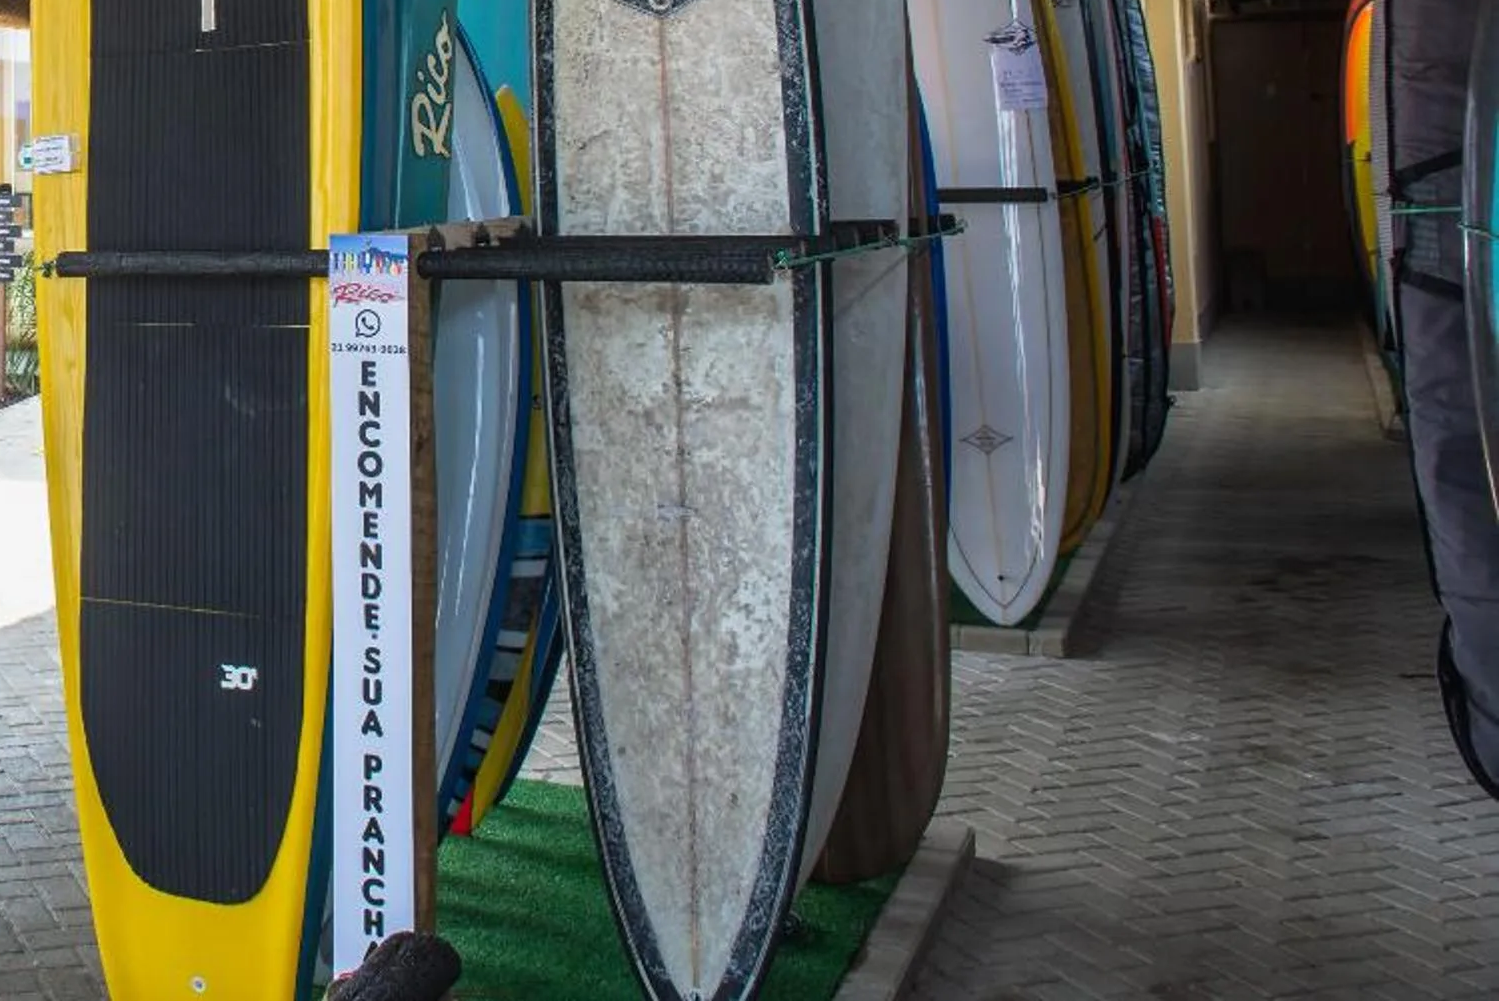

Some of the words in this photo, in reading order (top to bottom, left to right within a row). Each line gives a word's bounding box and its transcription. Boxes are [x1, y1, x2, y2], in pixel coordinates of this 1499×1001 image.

[412, 11, 452, 158] Rico
[333, 283, 405, 308] Rico
[357, 361, 383, 630] ENCOMENDE
[361, 647, 383, 738] SUA
